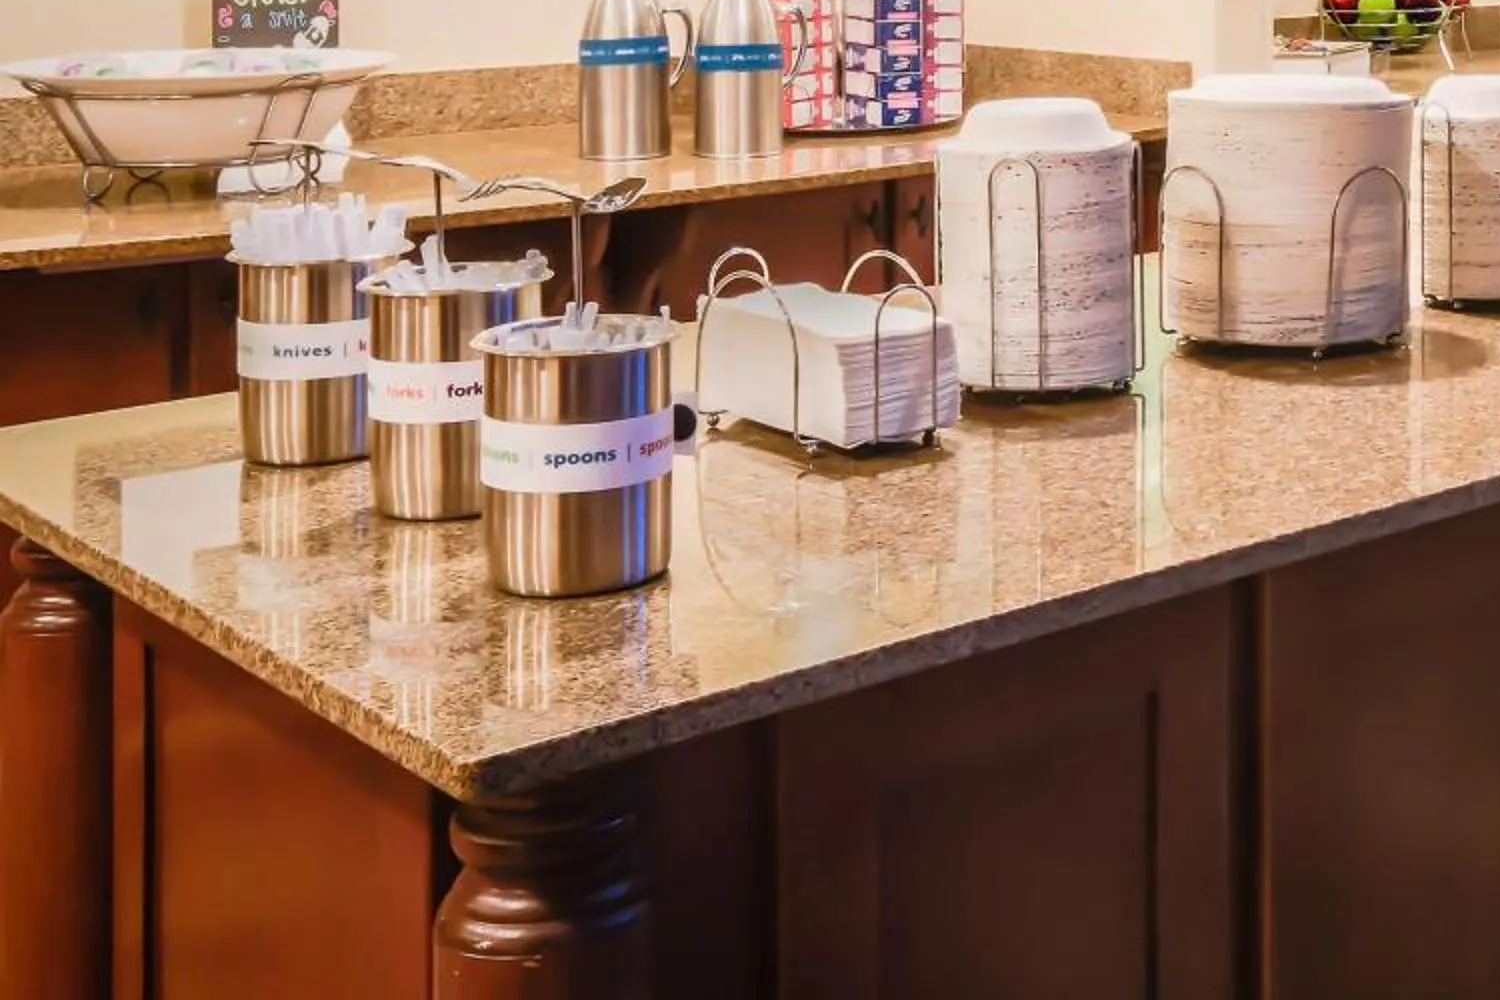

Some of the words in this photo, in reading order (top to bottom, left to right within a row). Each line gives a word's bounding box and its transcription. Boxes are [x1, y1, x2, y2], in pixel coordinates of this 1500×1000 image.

[272, 344, 333, 358] knives
[447, 381, 484, 398] fork
[543, 449, 617, 469] spoons
